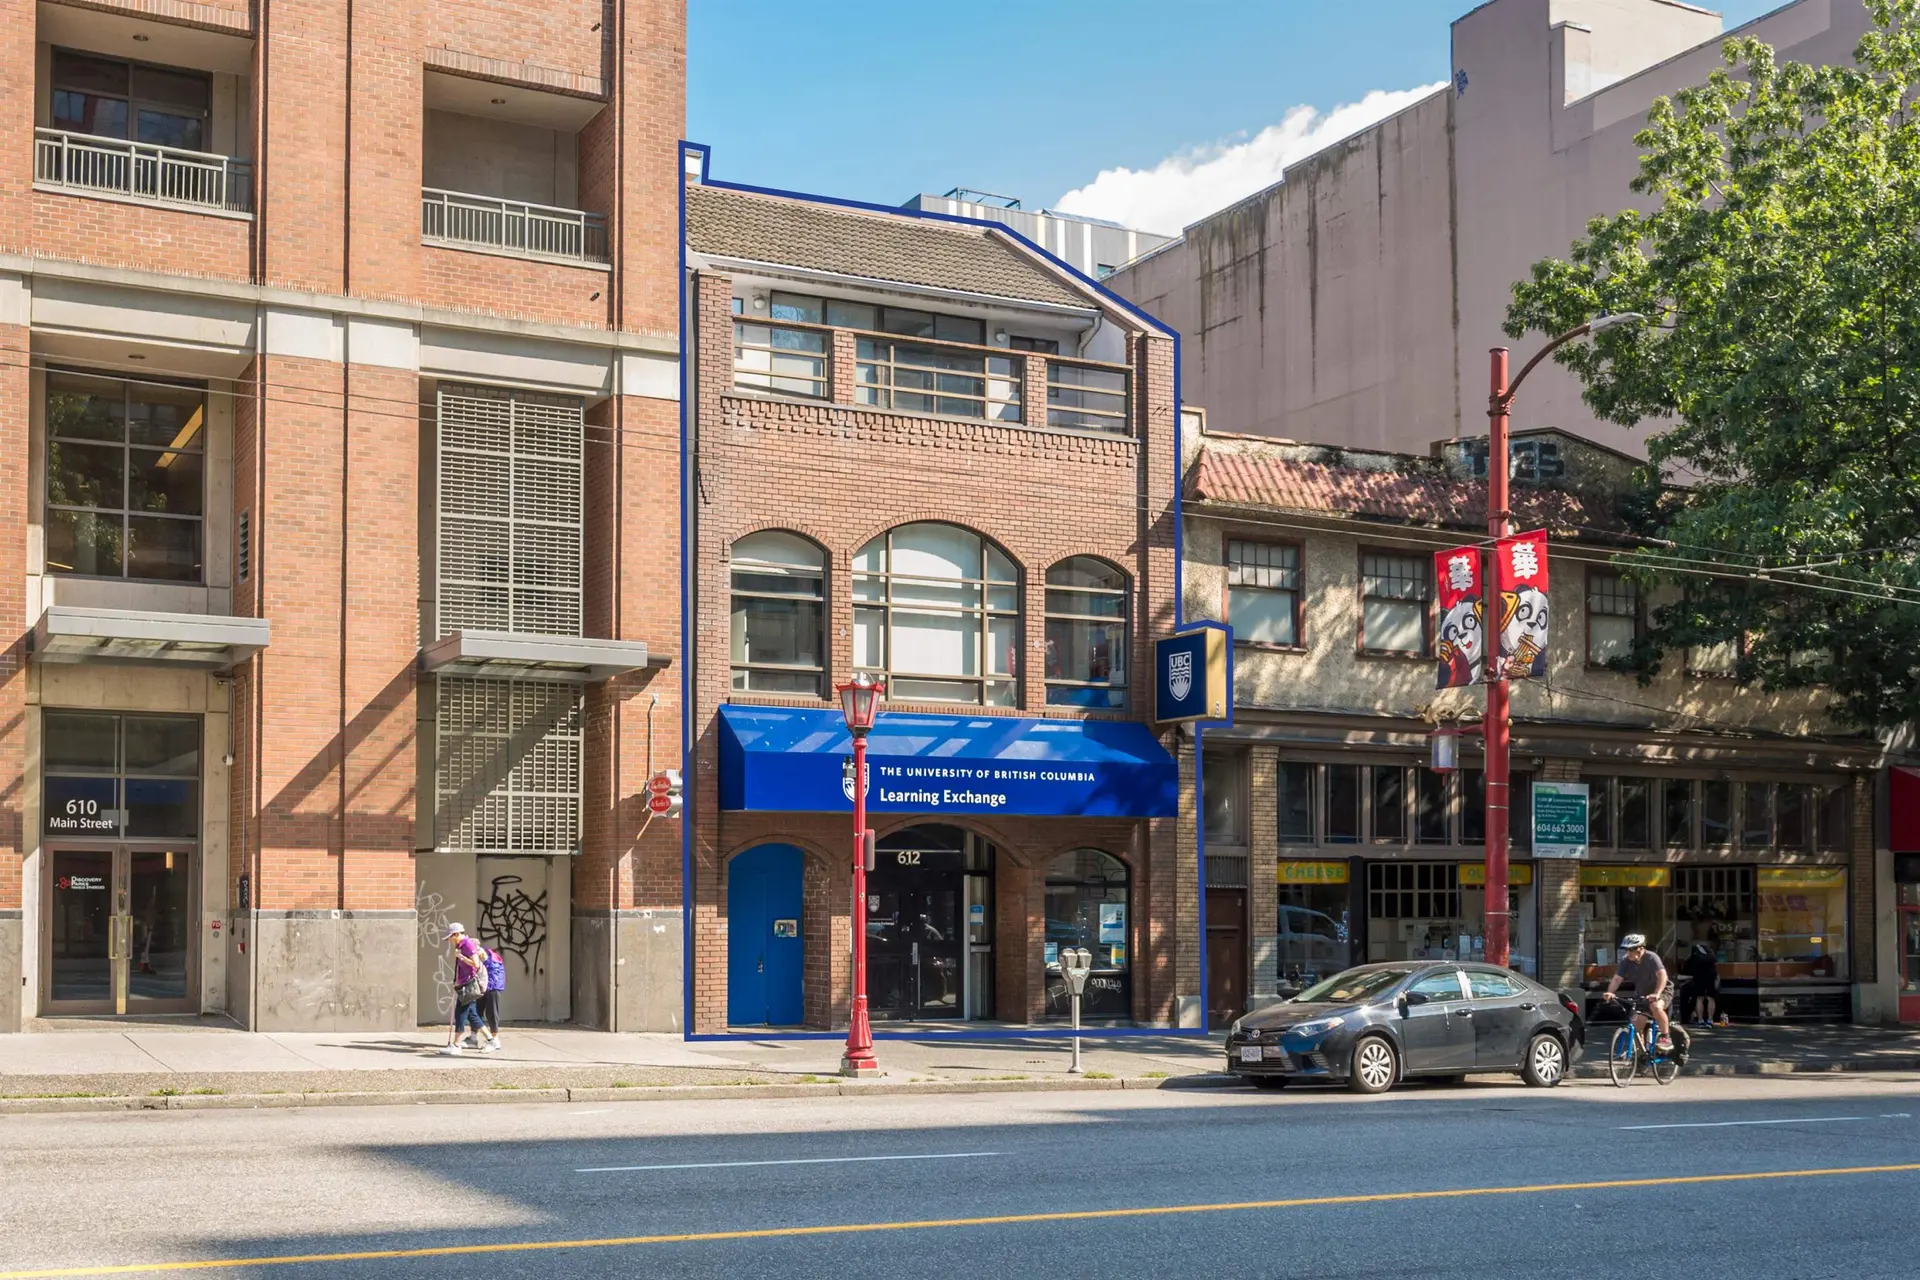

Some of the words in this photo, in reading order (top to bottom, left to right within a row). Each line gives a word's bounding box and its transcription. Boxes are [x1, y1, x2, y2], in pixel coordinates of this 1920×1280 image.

[1511, 541, 1539, 580] 華
[1448, 555, 1474, 592] 華
[1171, 654, 1190, 668] UBC
[880, 766, 902, 777] THE
[906, 767, 973, 779] UNIVERSITY
[976, 769, 990, 779] OF
[994, 770, 1036, 780] BRITISH
[1040, 771, 1095, 782] COLUMBIA
[880, 788, 940, 805] Learning
[943, 789, 1007, 807] Exchange
[66, 799, 97, 815] 610
[50, 817, 78, 828] Main
[80, 817, 113, 829] Street
[1536, 823, 1551, 832] 604
[1551, 823, 1566, 832] 662
[1566, 824, 1585, 833] 3000
[897, 850, 921, 865] 612
[1284, 866, 1344, 879] CHEESE
